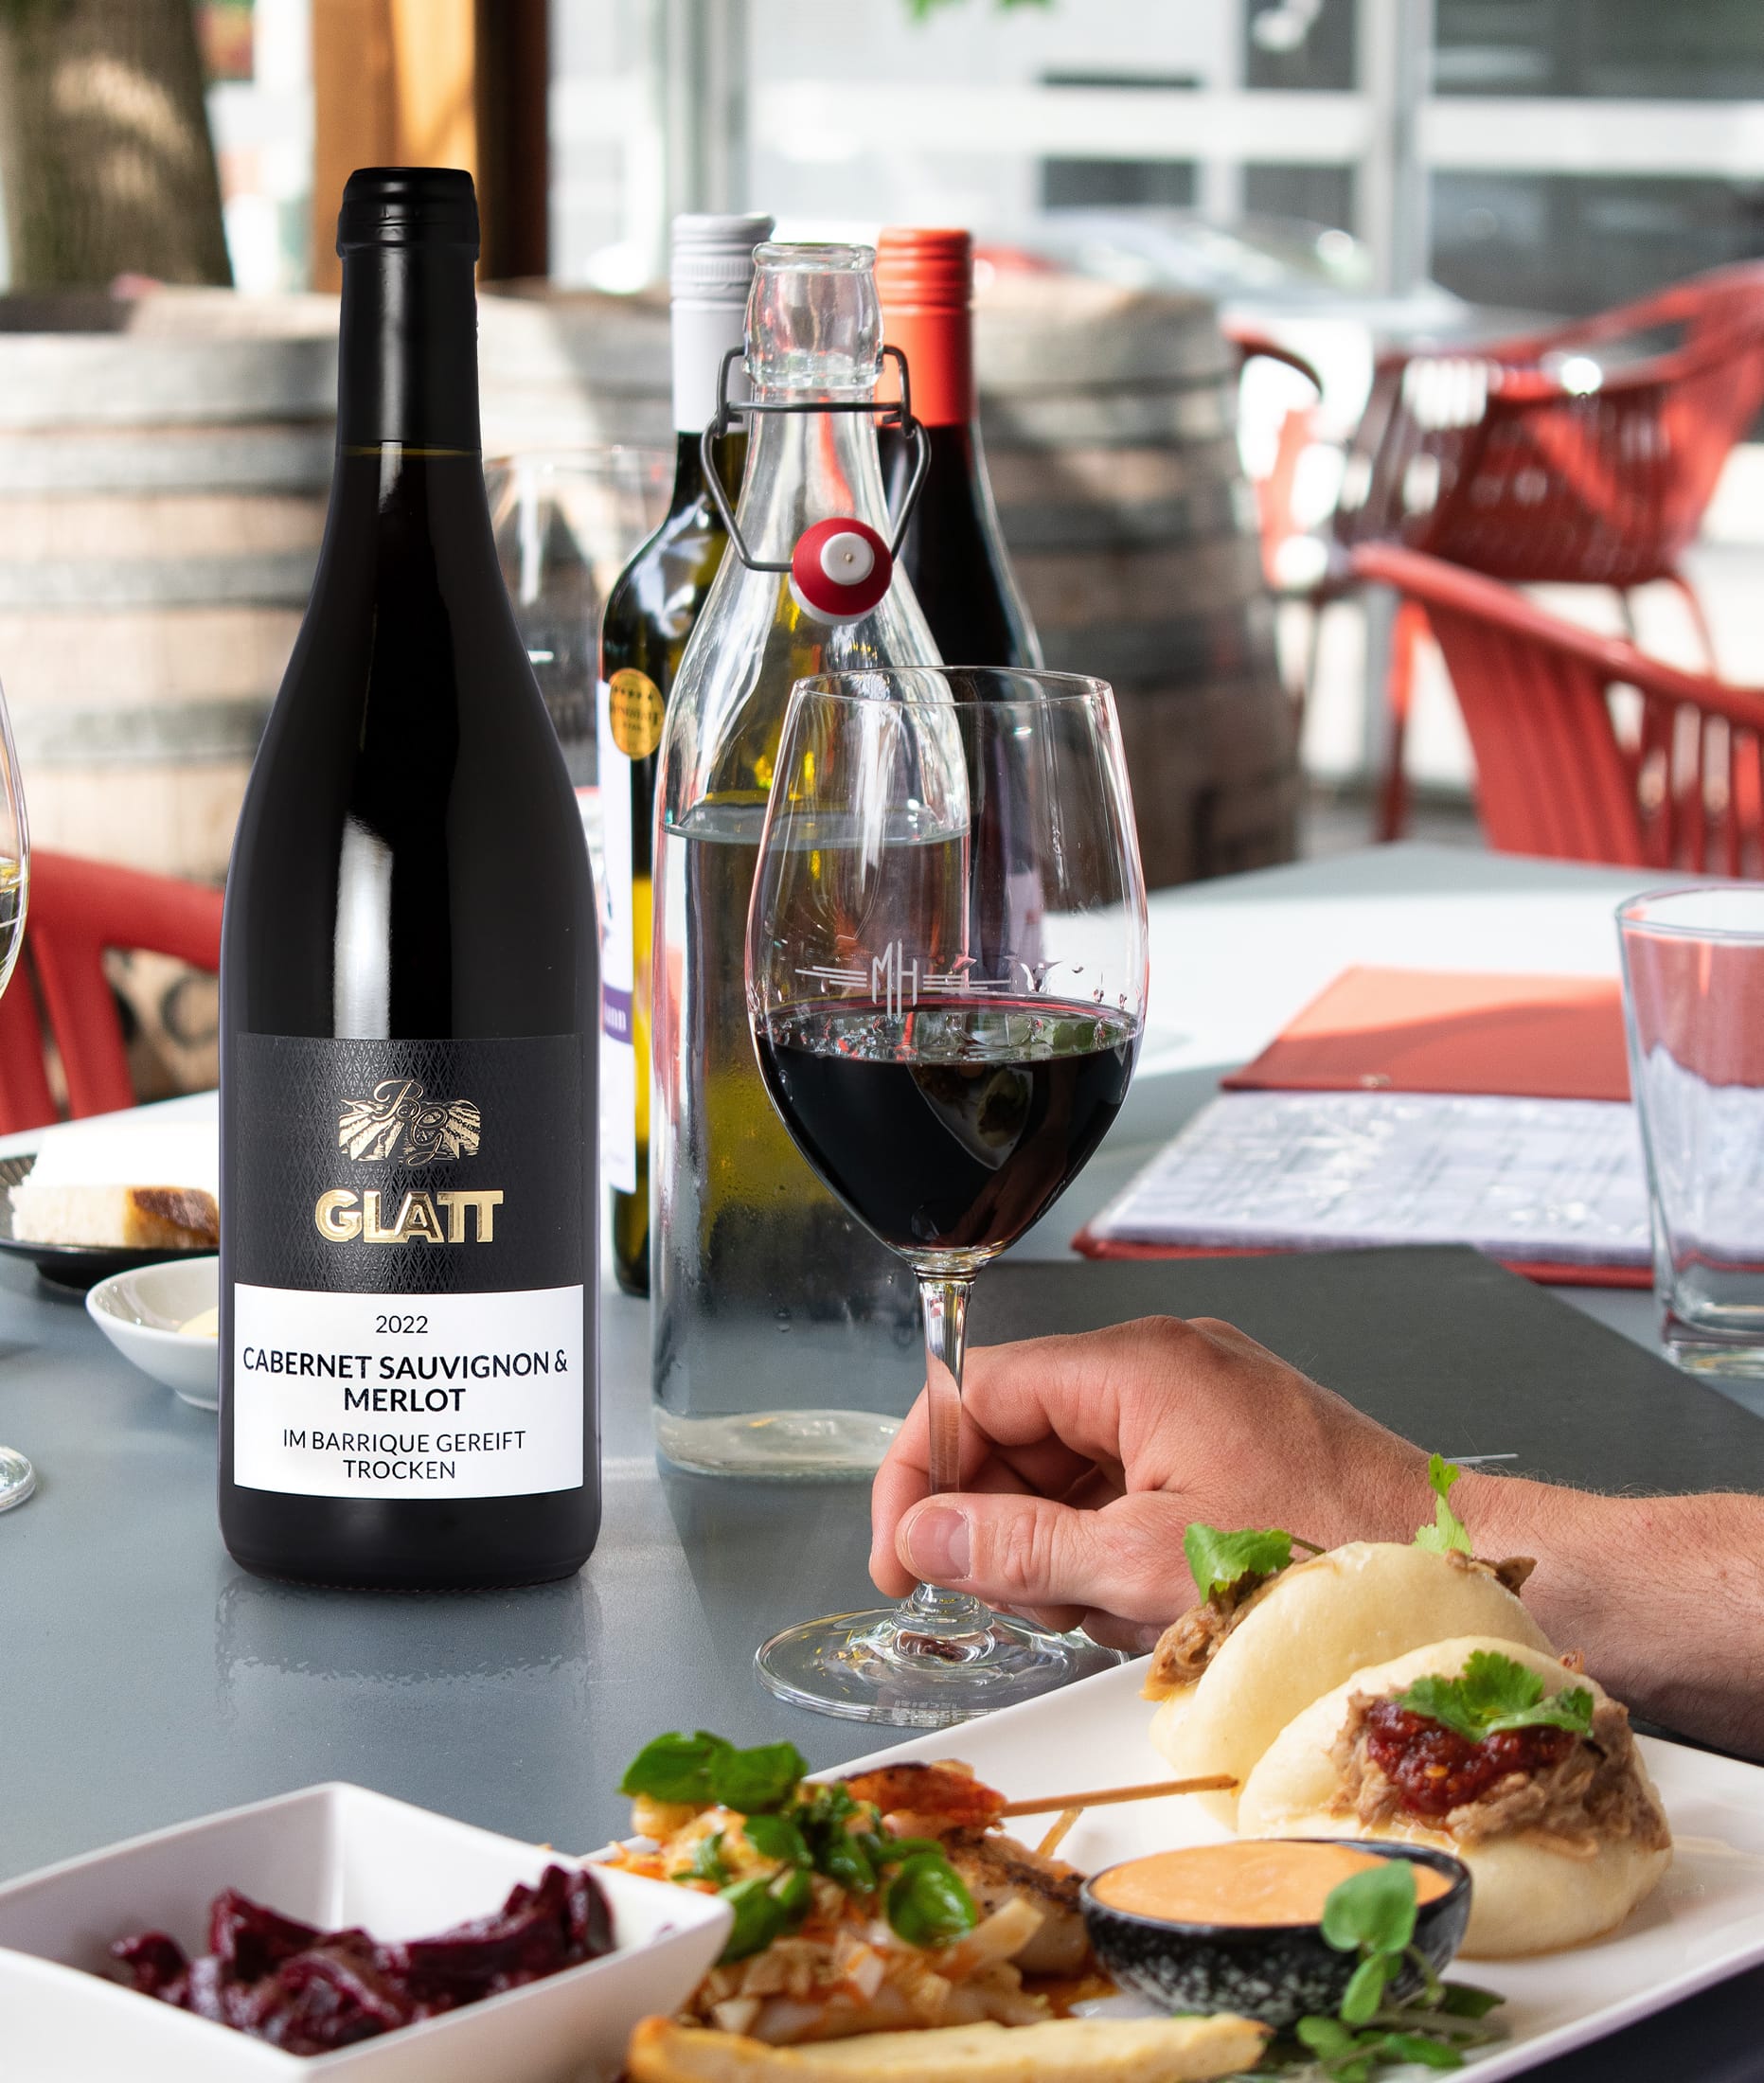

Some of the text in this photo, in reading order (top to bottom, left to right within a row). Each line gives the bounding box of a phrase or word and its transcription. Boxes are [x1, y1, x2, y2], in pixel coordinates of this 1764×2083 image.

[314, 1188, 504, 1244] GLATT
[376, 1314, 429, 1334] 2022
[242, 1346, 568, 1380] CABERNET SAUVIGNON &
[344, 1387, 467, 1413] MERLOT
[283, 1429, 526, 1455] IM BARRIQUE GEREIFT
[343, 1459, 455, 1480] TROCKEN
